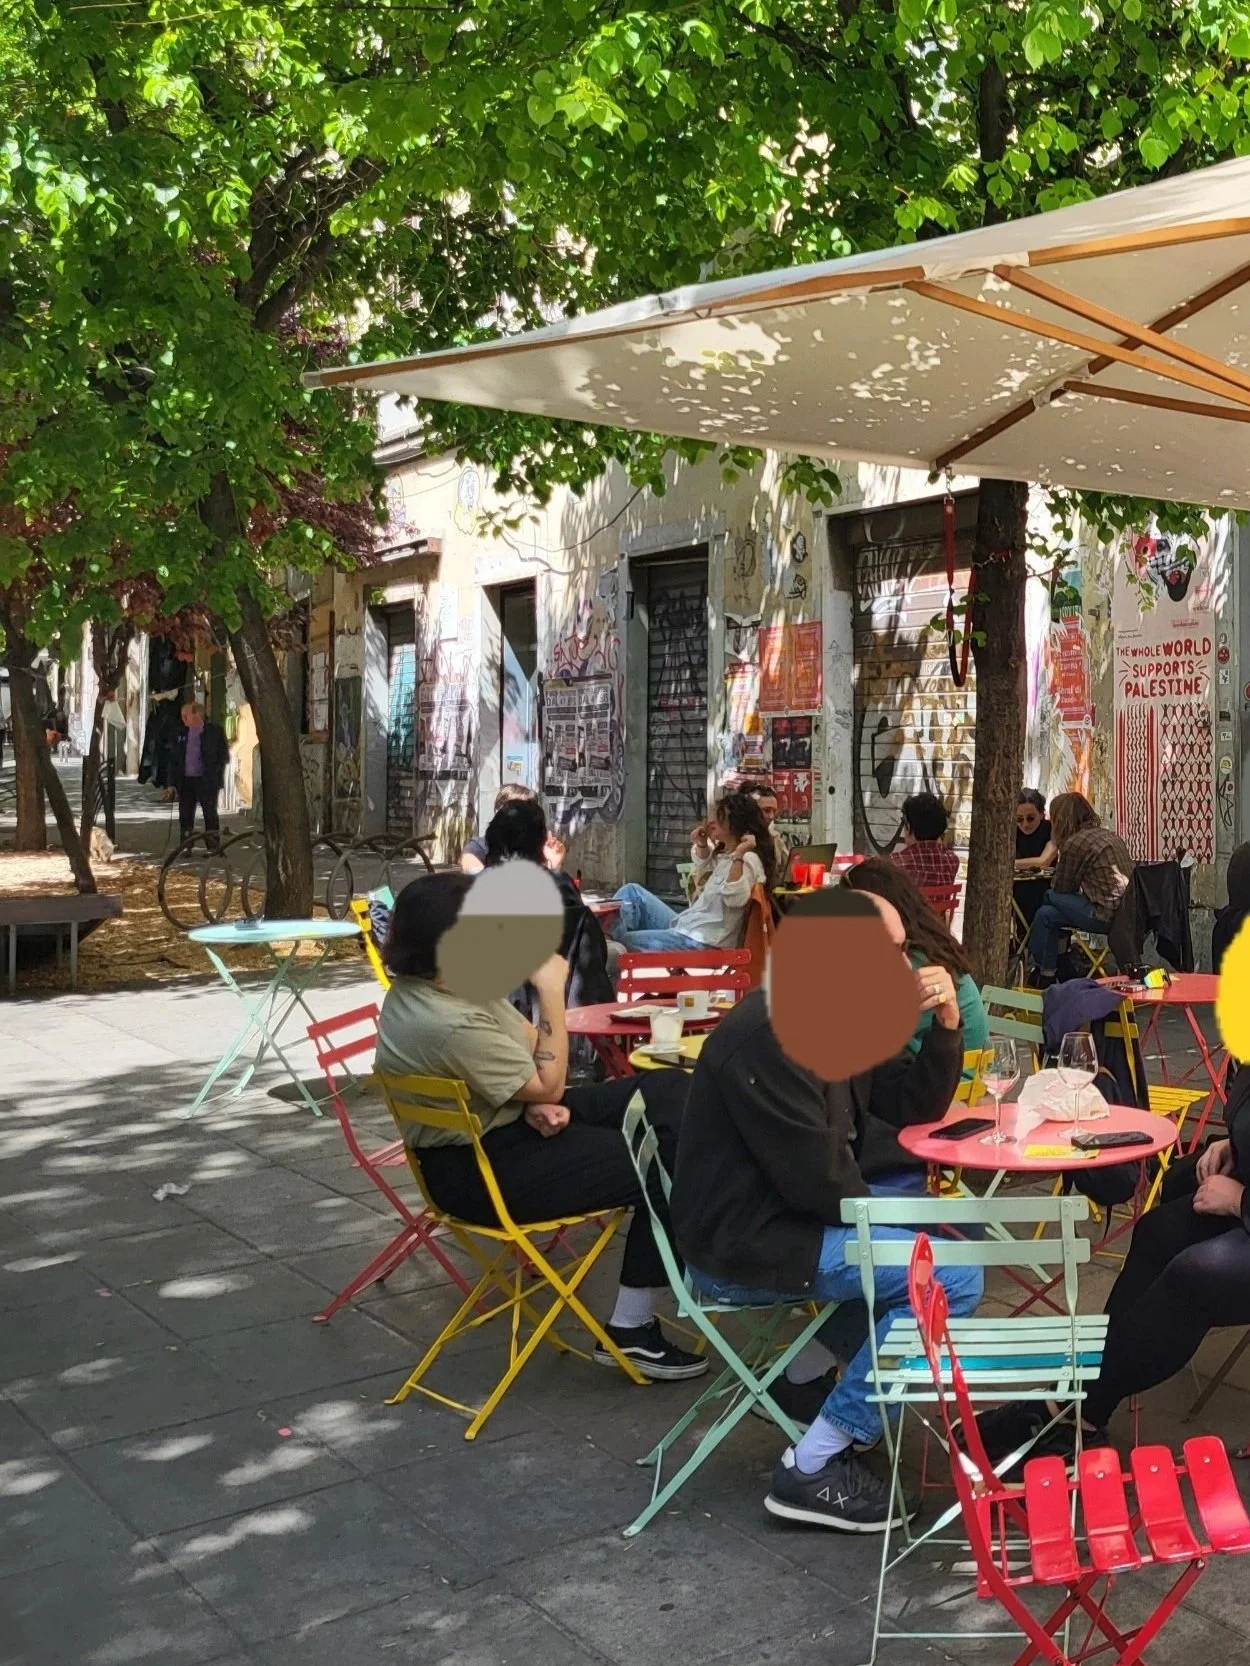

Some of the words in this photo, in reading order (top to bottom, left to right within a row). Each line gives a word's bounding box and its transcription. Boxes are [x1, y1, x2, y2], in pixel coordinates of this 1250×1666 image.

[1116, 647, 1130, 657] THE
[1131, 645, 1161, 657] WHOLE
[1163, 637, 1212, 657] WORLD
[1132, 659, 1194, 678] SUPPORTS
[1124, 676, 1203, 699] PALESTINE
